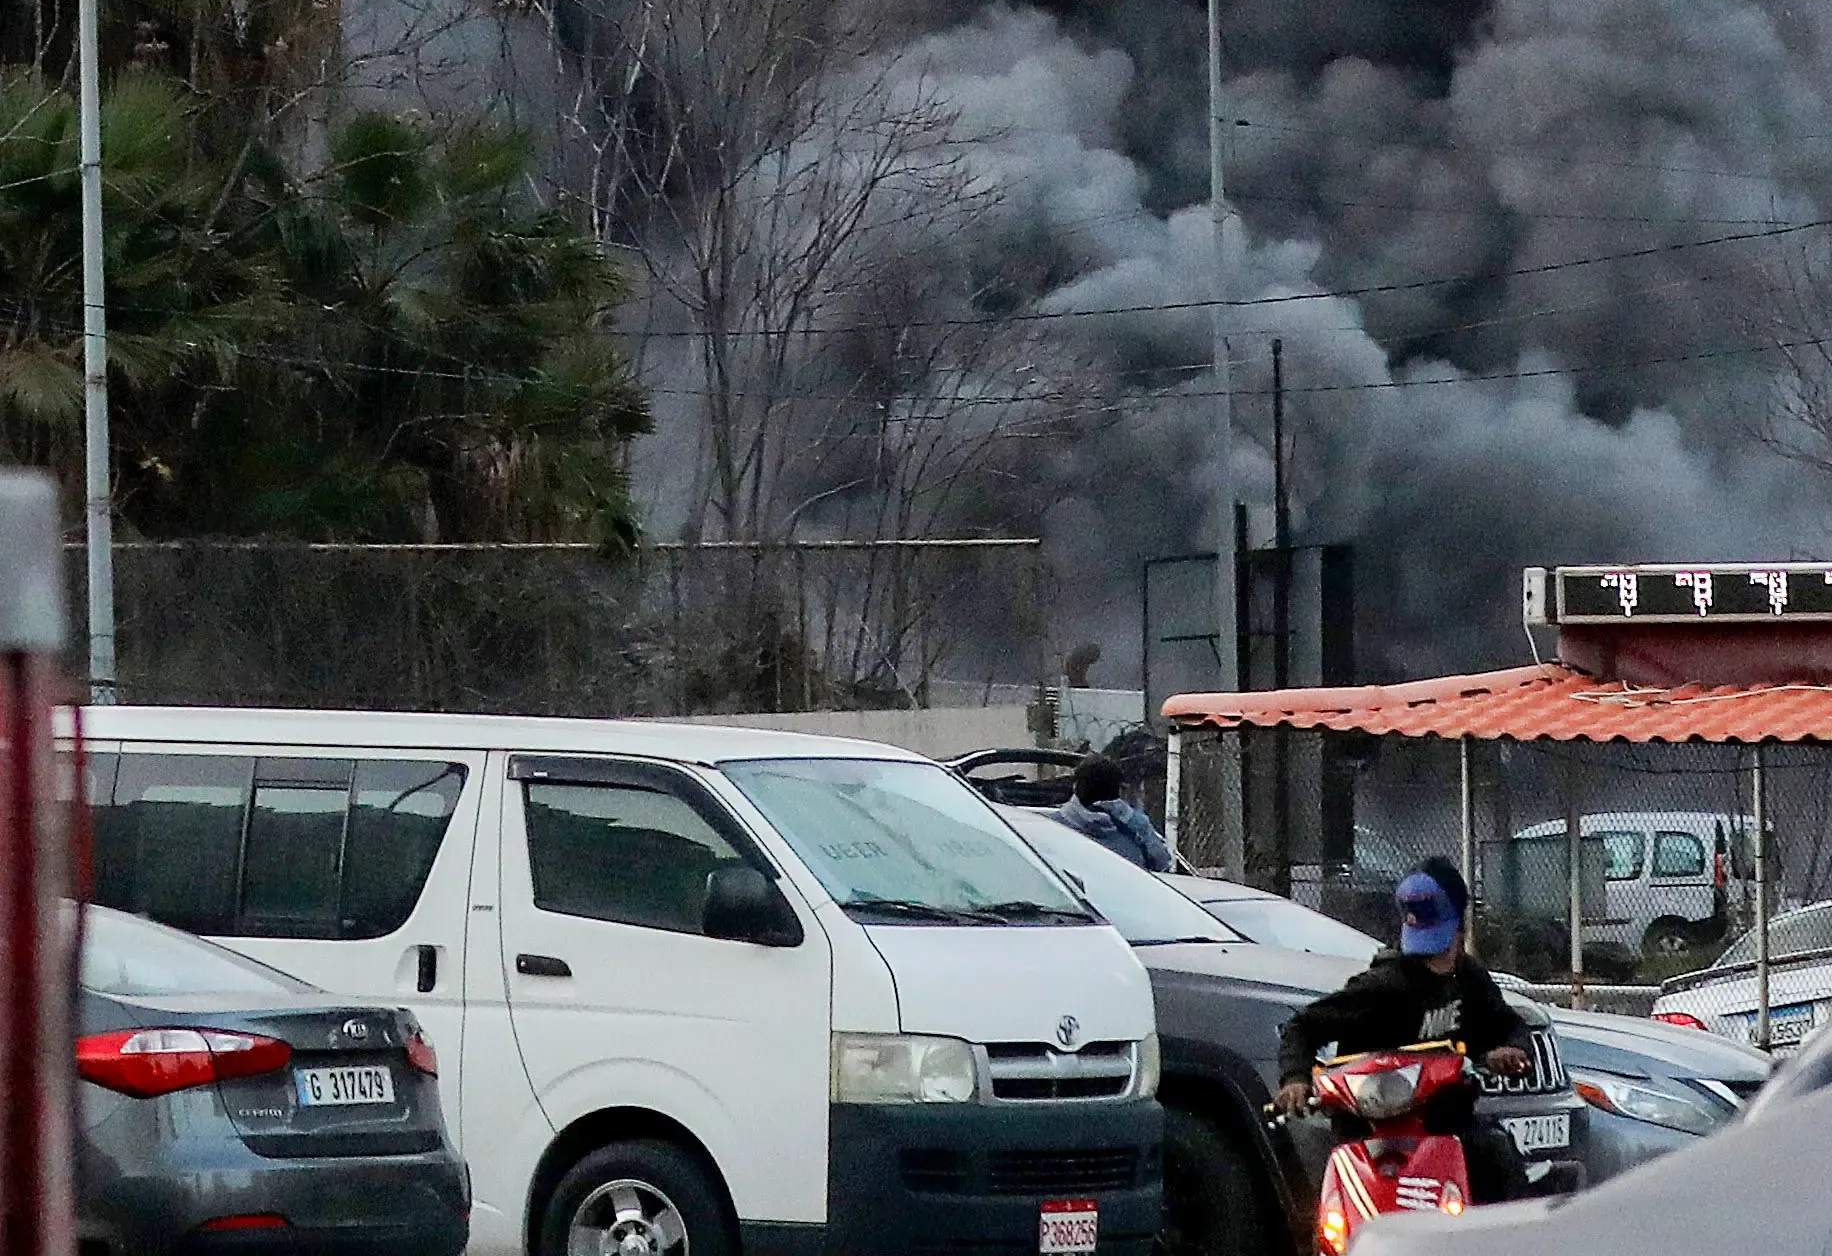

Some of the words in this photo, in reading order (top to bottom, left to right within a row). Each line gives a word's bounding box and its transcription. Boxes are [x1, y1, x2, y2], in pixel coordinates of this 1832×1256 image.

[310, 1073, 322, 1101] G
[329, 1069, 384, 1101] 317479
[1523, 1117, 1565, 1146] 274115
